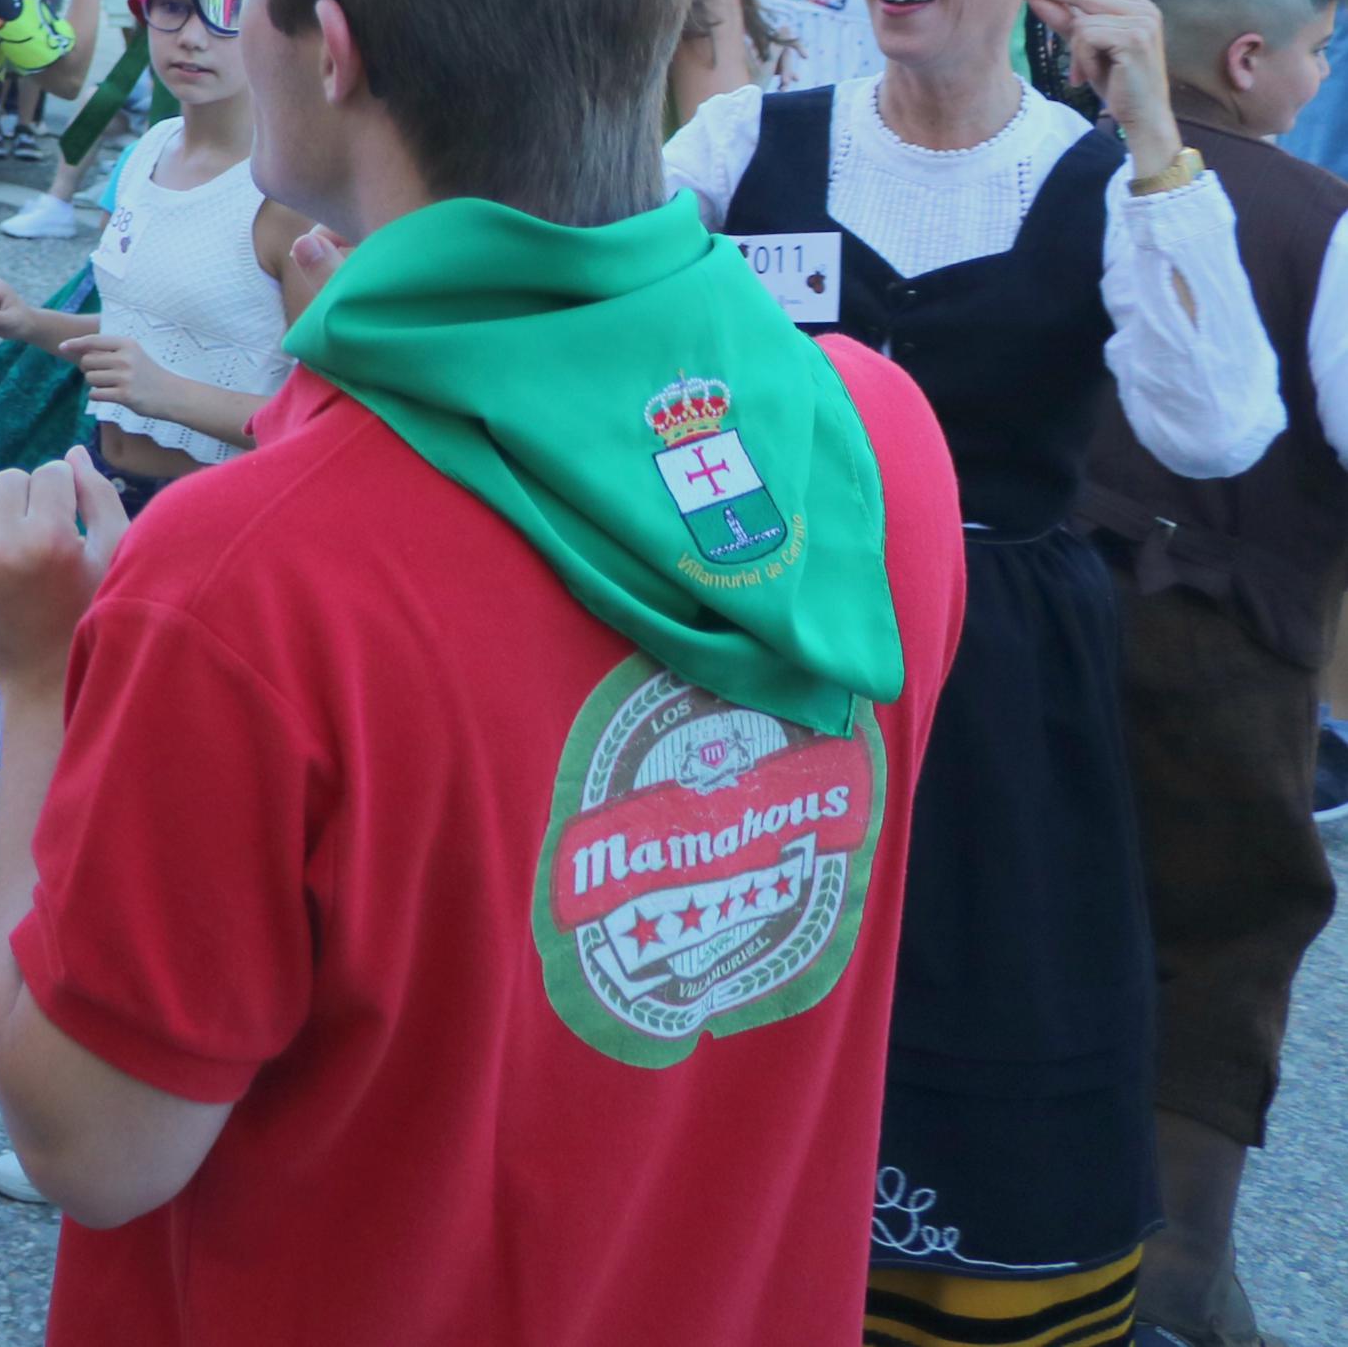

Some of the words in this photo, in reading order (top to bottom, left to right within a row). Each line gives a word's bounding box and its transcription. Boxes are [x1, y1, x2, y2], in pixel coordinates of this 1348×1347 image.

[754, 245, 803, 274] 011
[677, 552, 762, 589] Villamuriel
[766, 561, 784, 580] de
[650, 698, 692, 735] LOS
[679, 935, 772, 998] VILLAMURIEL
